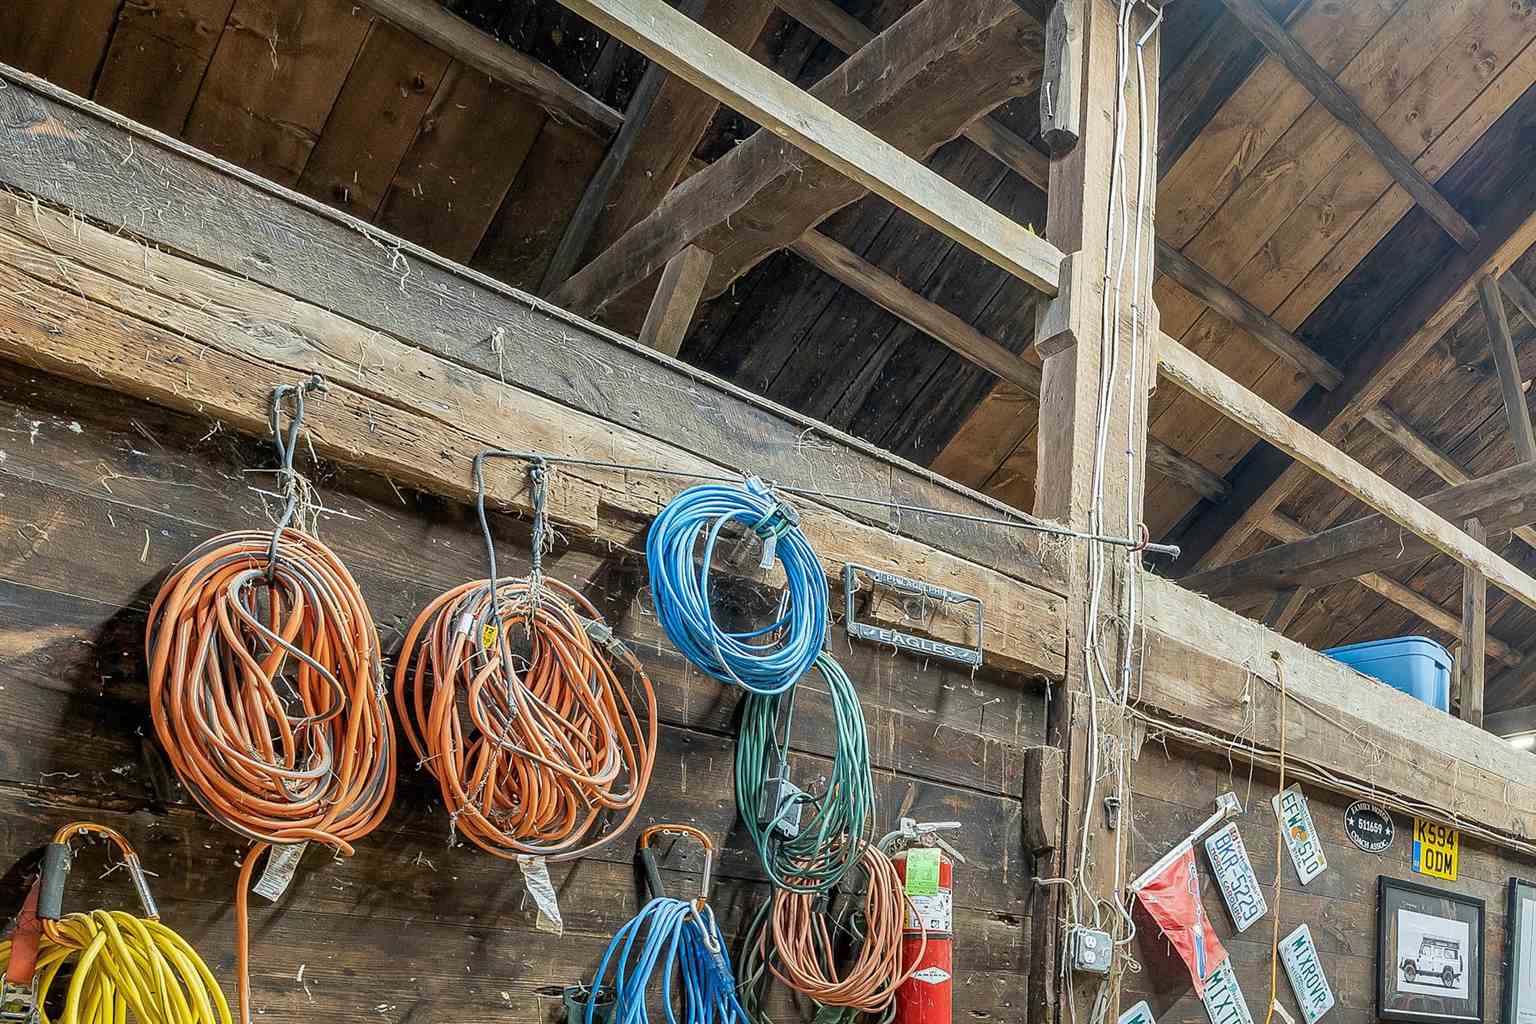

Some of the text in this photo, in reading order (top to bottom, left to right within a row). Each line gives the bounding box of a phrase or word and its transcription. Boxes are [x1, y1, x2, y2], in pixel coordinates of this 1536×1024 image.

[879, 630, 956, 656] EAGLES
[1425, 848, 1453, 875] ODM
[1291, 935, 1327, 1008] MIXROVR
